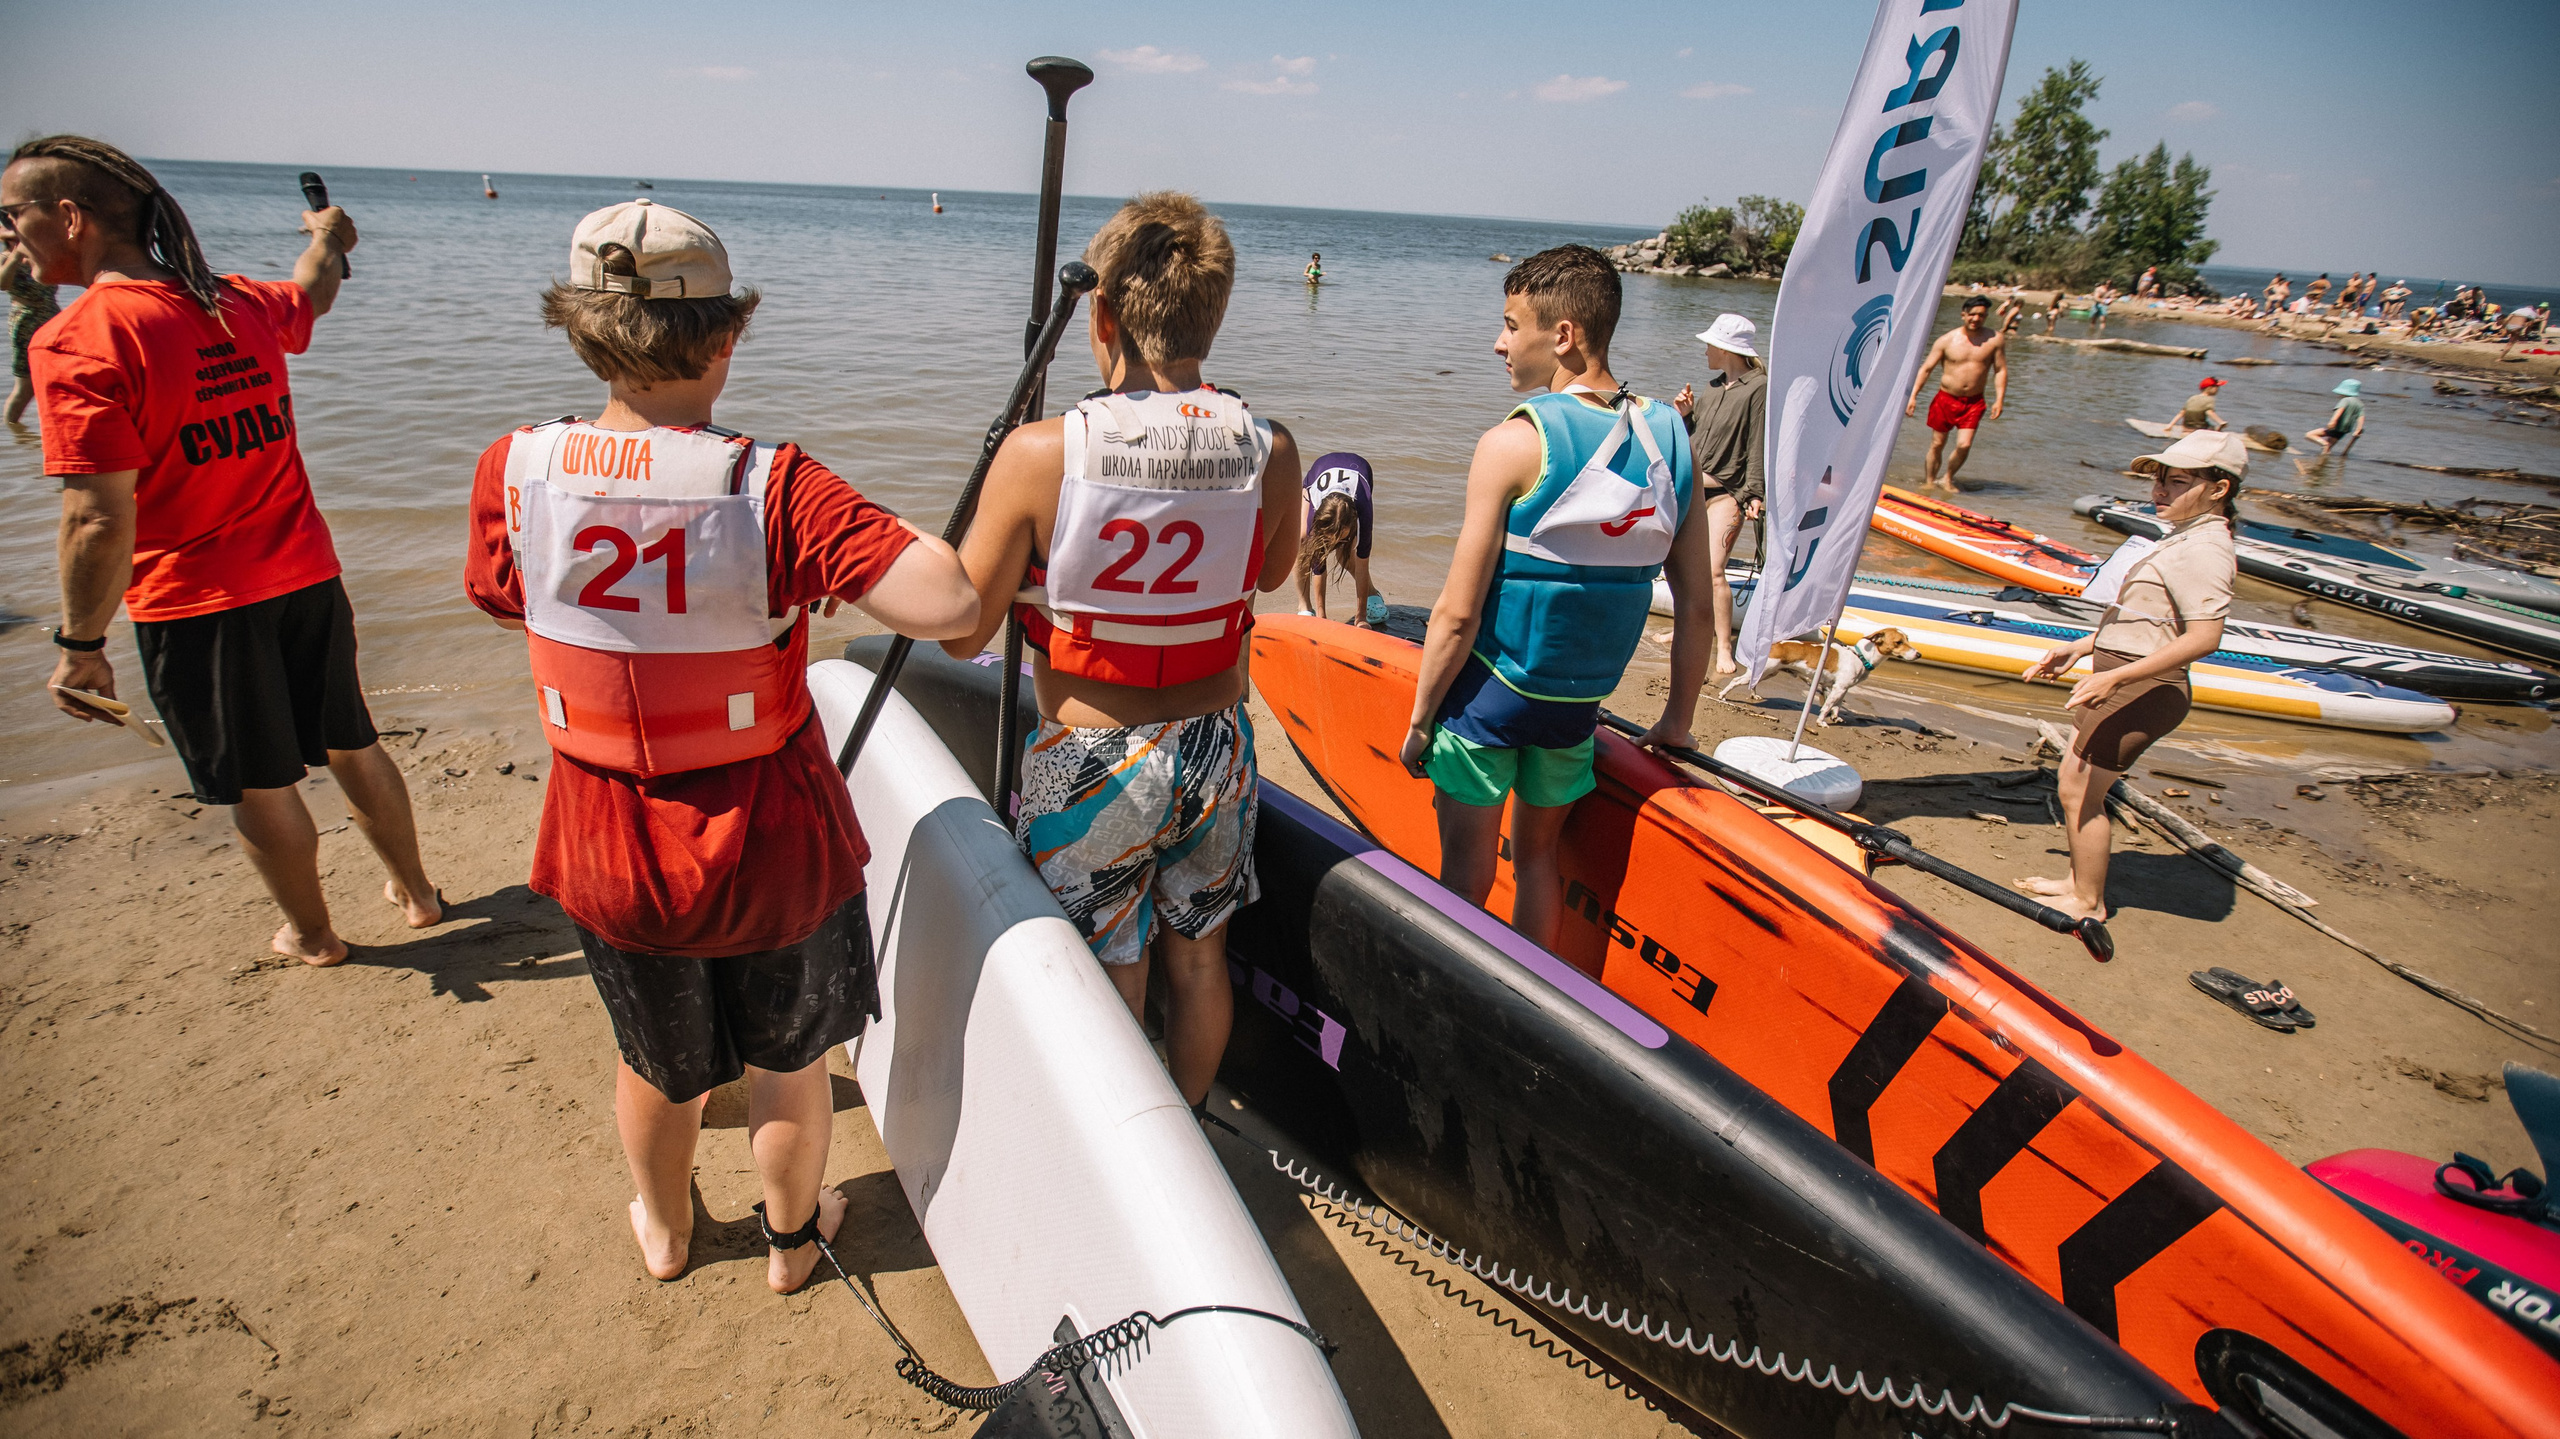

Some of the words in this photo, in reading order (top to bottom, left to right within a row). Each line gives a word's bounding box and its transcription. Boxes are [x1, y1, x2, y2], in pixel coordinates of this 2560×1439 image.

[562, 432, 653, 481] ШКОЛА
[1101, 455, 1142, 478] ШКОЛА
[1148, 456, 1215, 480] ПАРУСНОГО
[1218, 455, 1255, 479] СПОРТА
[1316, 468, 1351, 492] 10
[572, 524, 688, 614] 21
[1090, 518, 1205, 595] 22
